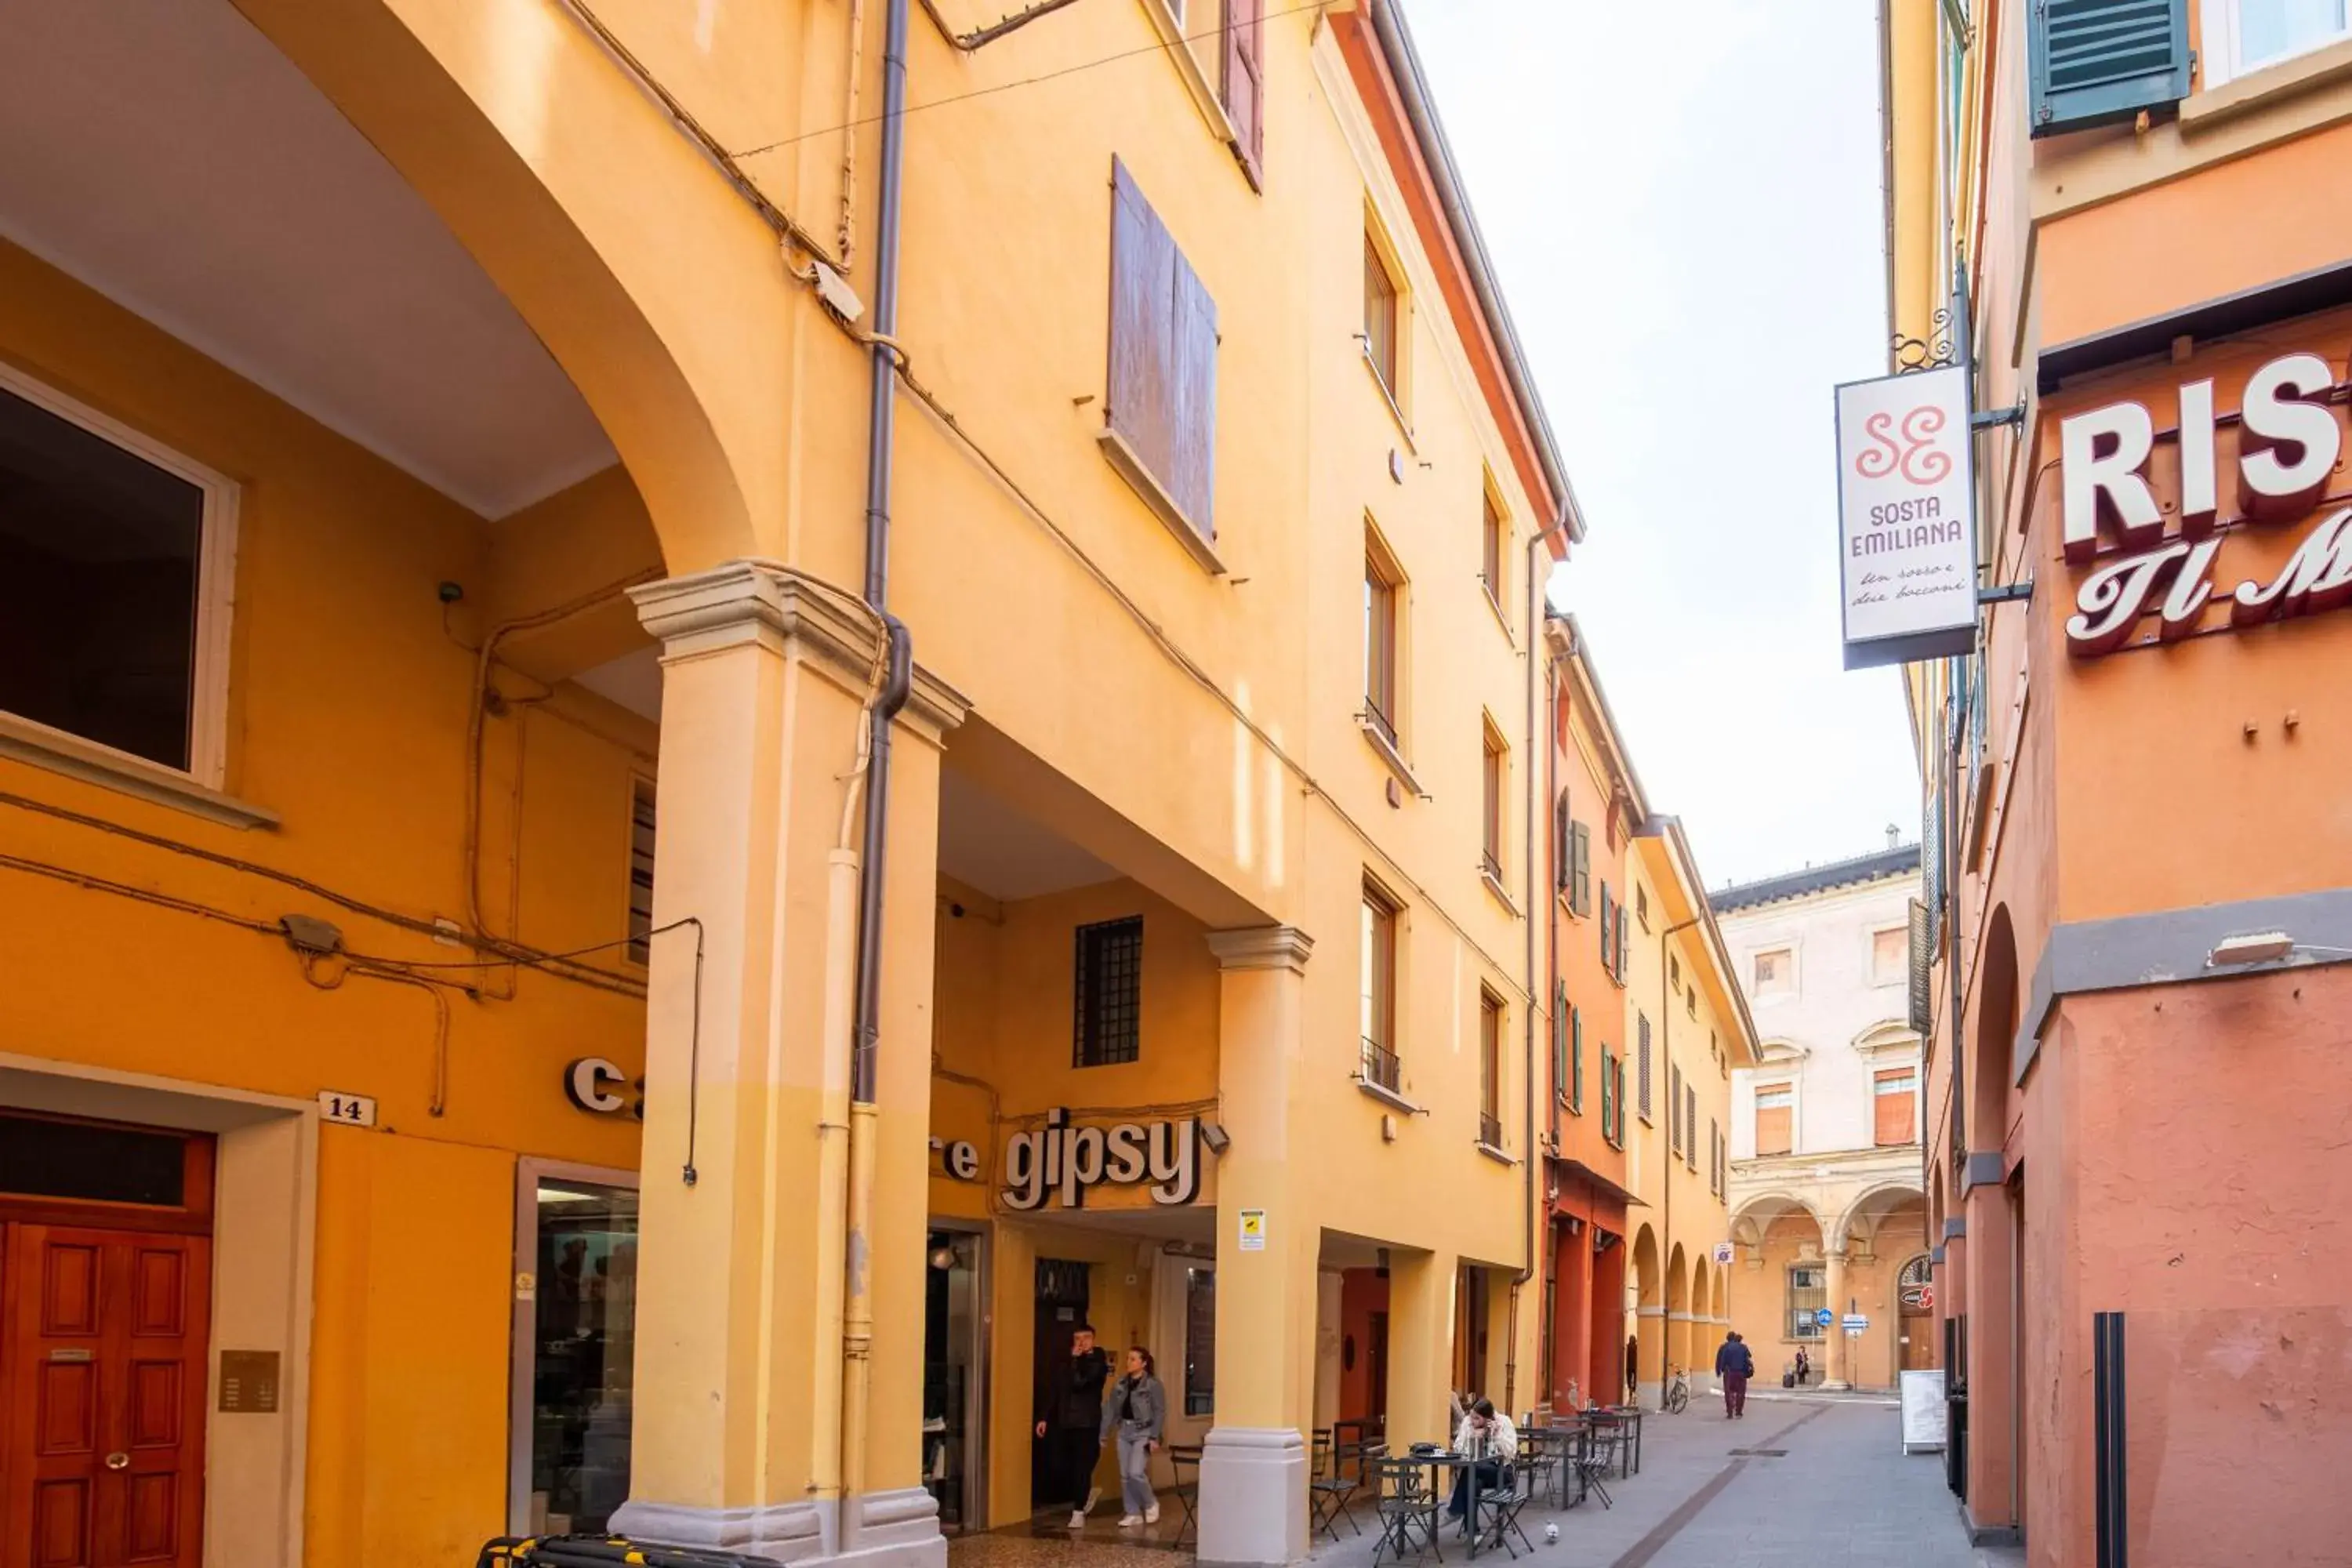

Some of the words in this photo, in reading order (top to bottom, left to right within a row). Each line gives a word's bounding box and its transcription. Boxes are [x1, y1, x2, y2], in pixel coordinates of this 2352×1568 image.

[1856, 405, 1951, 485] SE
[1871, 496, 1940, 527] SOSTA
[1852, 520, 1962, 557] EMILIANA
[329, 1097, 363, 1121] 14
[1001, 1106, 1200, 1210] gipsy
